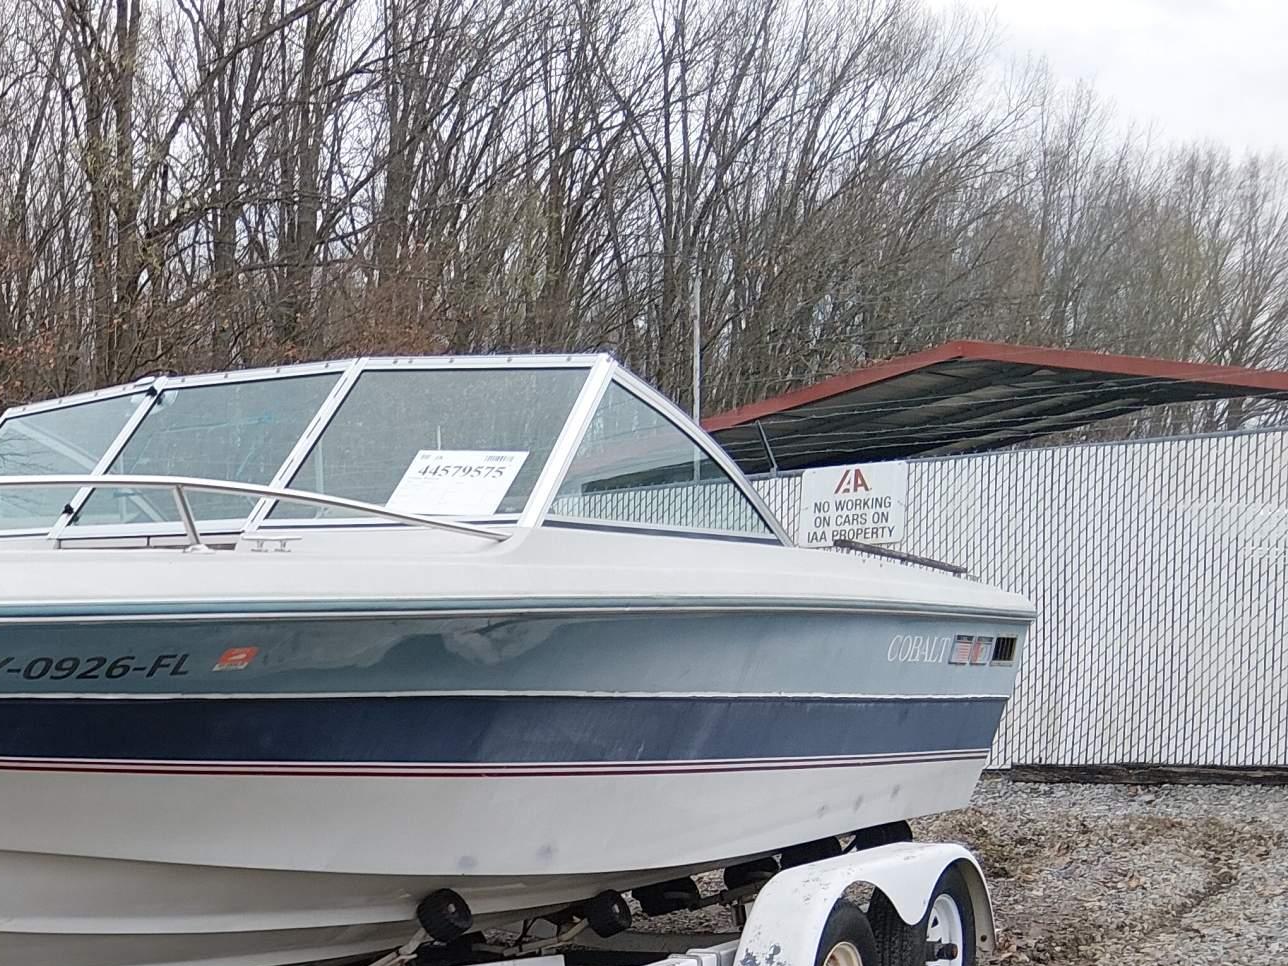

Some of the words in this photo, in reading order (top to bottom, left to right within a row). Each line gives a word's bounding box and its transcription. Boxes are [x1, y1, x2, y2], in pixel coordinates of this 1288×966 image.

[418, 464, 507, 479] 44579575
[813, 500, 831, 514] NO
[834, 496, 892, 512] WORKING
[814, 516, 831, 529] ON
[835, 513, 868, 527] CARS
[872, 511, 889, 524] ON
[807, 531, 827, 543] IAA
[832, 526, 896, 541] PROPERTY
[887, 634, 952, 663] COBALT
